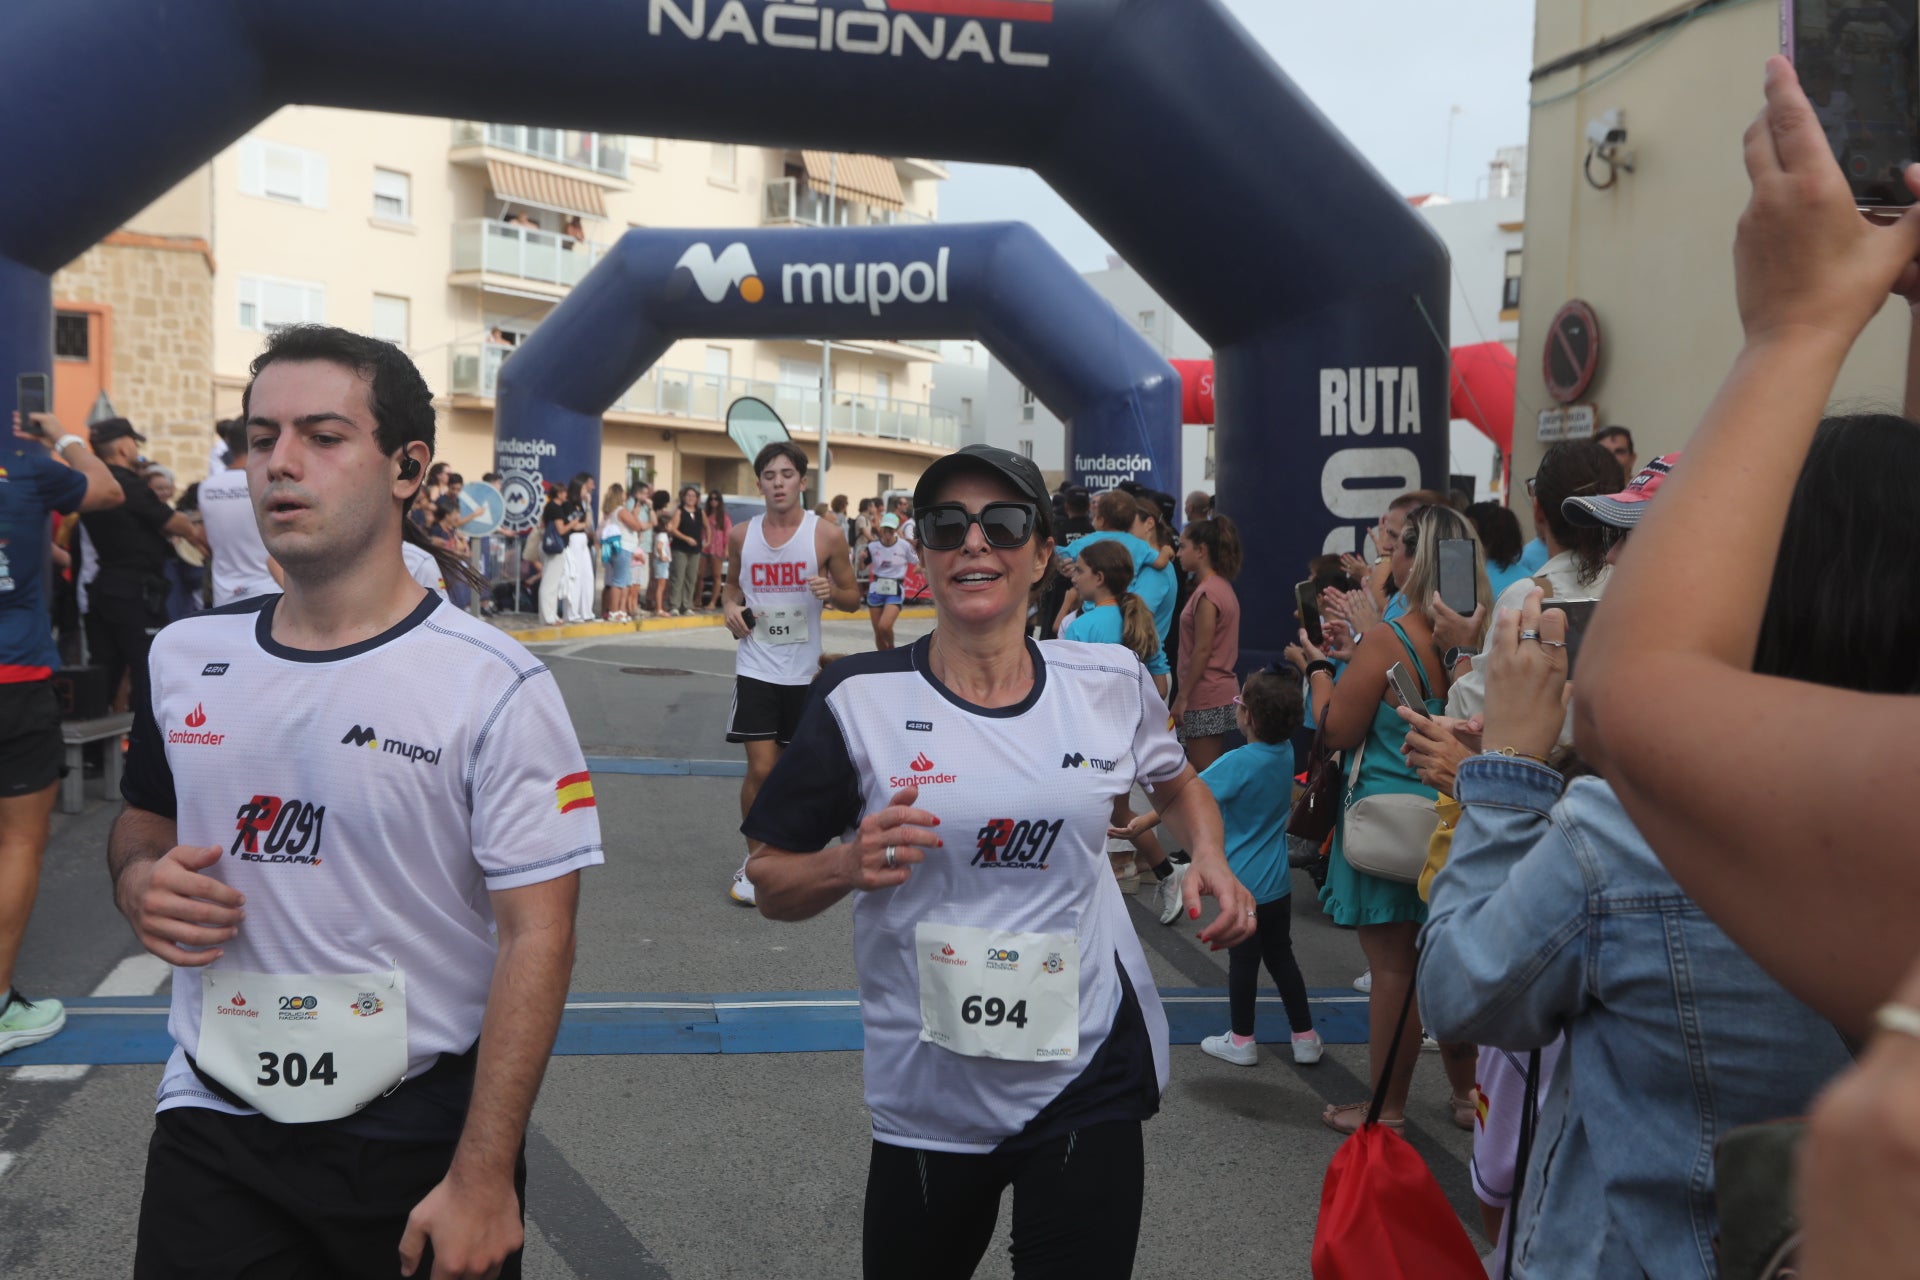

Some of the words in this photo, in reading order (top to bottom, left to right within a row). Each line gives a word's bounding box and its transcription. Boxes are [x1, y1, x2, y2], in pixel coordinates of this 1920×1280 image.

[648, 0, 1050, 67] NACIONAL
[781, 246, 950, 316] mupol
[1319, 366, 1422, 437] RUTA
[496, 437, 557, 457] undación
[499, 454, 540, 471] mupol
[1075, 453, 1152, 471] fundación
[751, 562, 807, 587] CNBC
[768, 625, 790, 635] 651
[907, 722, 931, 731] 42K
[168, 729, 225, 746] Santander
[382, 738, 442, 766] mupol
[889, 773, 957, 788] Santander
[240, 853, 317, 866] SOLIDARIA
[930, 952, 968, 966] Santander
[278, 995, 318, 1010] 200
[217, 1005, 259, 1018] Santander
[961, 995, 1028, 1029] 694
[257, 1051, 338, 1088] 304
